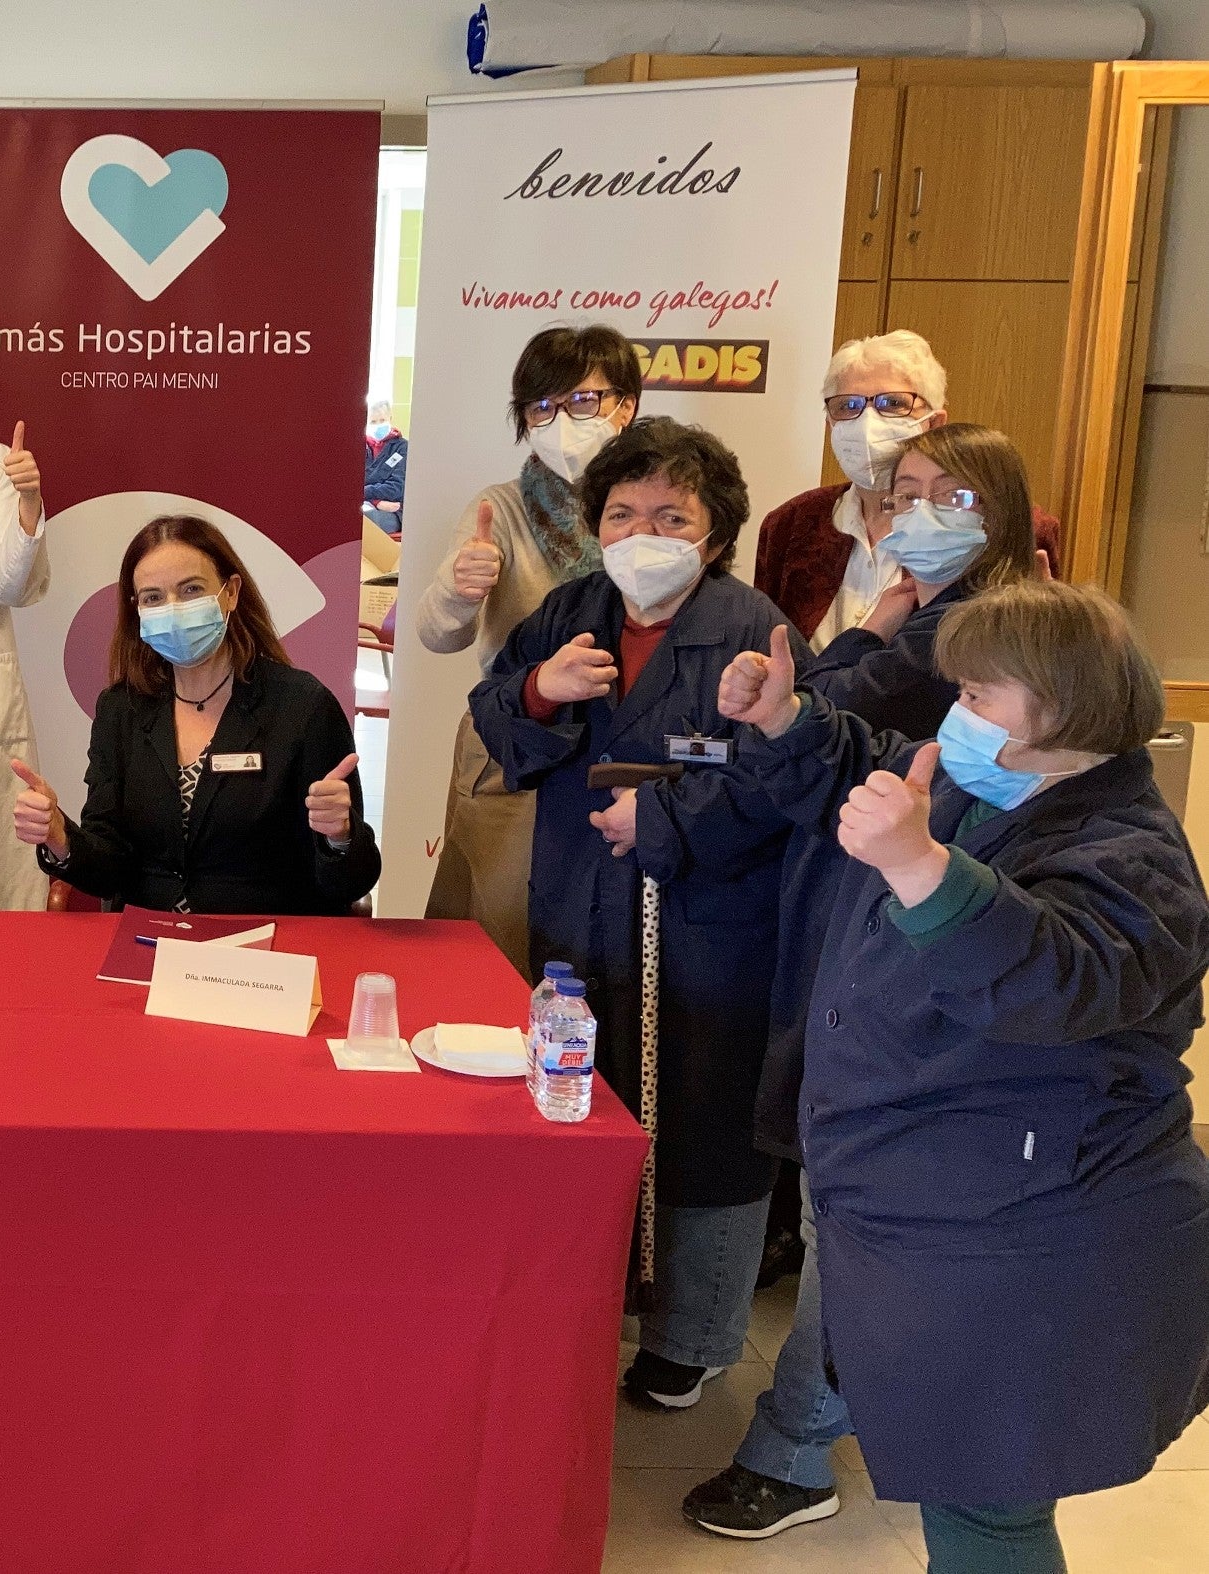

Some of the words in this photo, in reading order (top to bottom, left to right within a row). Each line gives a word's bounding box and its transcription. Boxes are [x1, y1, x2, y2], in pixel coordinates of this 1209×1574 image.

[503, 141, 742, 200] benvidos
[462, 281, 563, 310] Vivamos
[570, 289, 641, 310] como
[646, 279, 779, 329] galegos!
[78, 322, 312, 361] Hospitalarias
[60, 371, 130, 389] CENTRO
[133, 372, 159, 389] PAI
[162, 373, 219, 390] MENNI
[251, 981, 285, 992] SEGARRA
